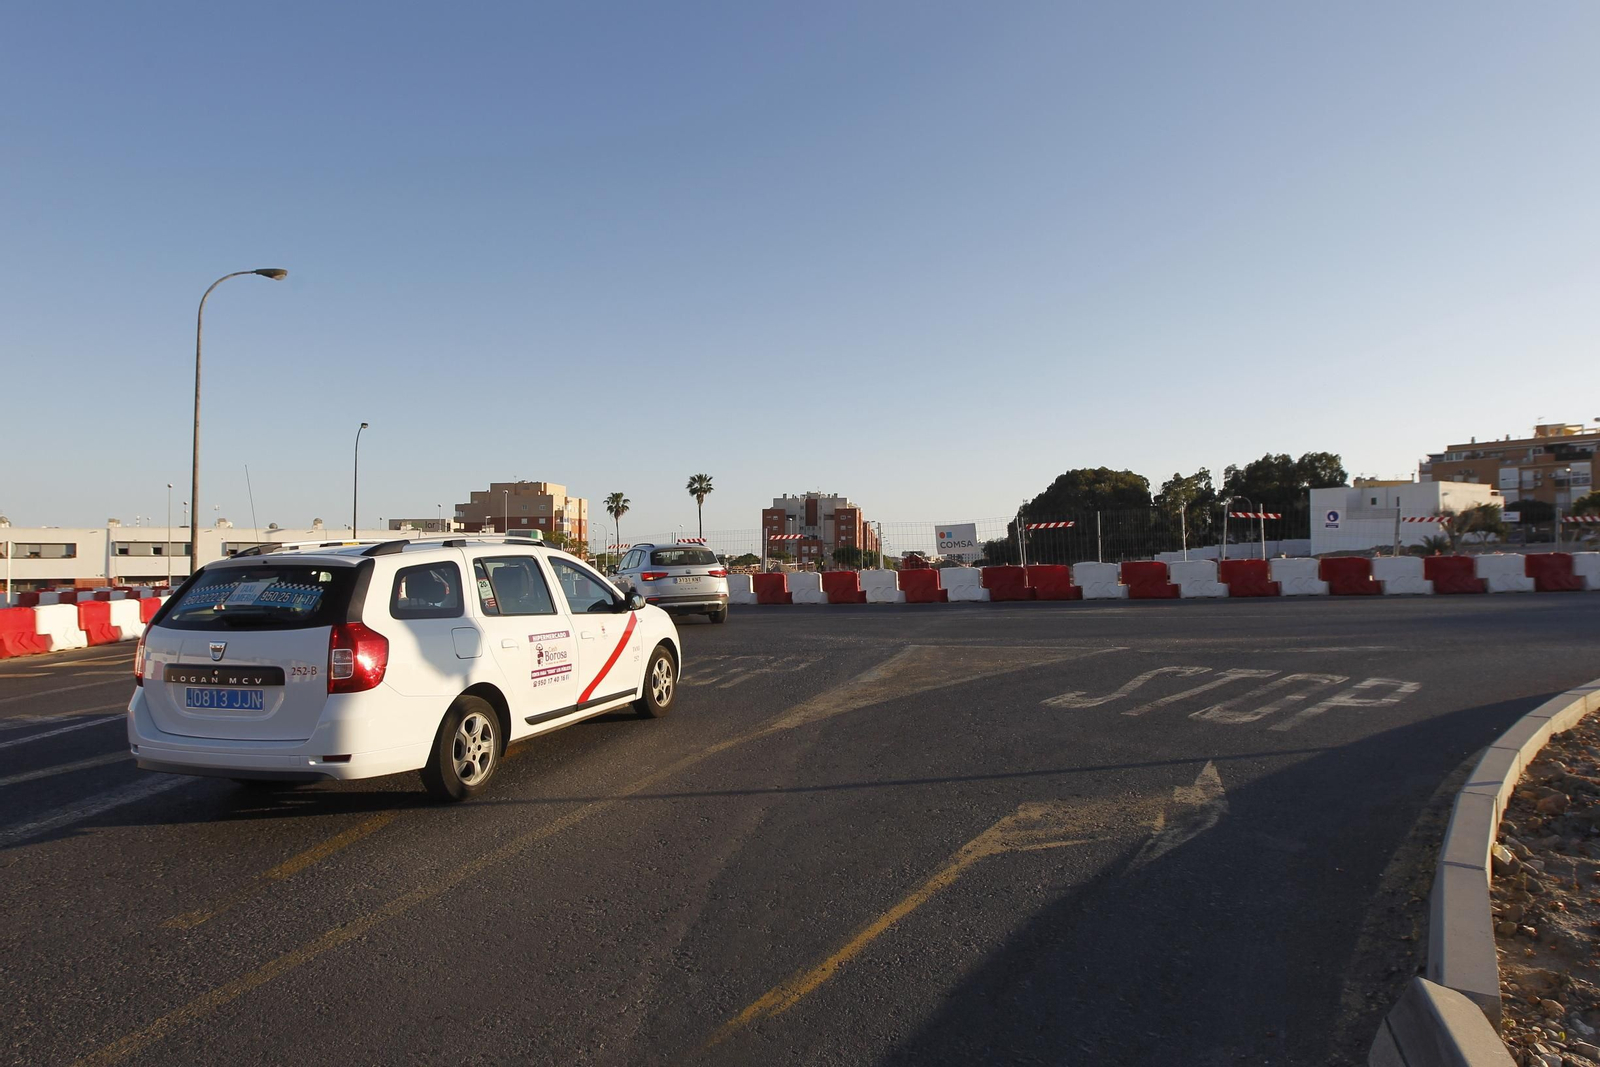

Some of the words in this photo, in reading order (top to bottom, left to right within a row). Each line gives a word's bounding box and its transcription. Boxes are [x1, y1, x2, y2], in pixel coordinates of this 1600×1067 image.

[940, 540, 974, 549] COMSA
[261, 592, 278, 602] 950
[279, 592, 289, 603] 25
[545, 650, 567, 661] Borosa
[291, 666, 318, 676] 252-B
[171, 675, 219, 684] LOGAN
[229, 677, 263, 685] MCV
[194, 689, 228, 707] 0813
[233, 690, 261, 709] JJN
[1041, 666, 1422, 731] STOP
